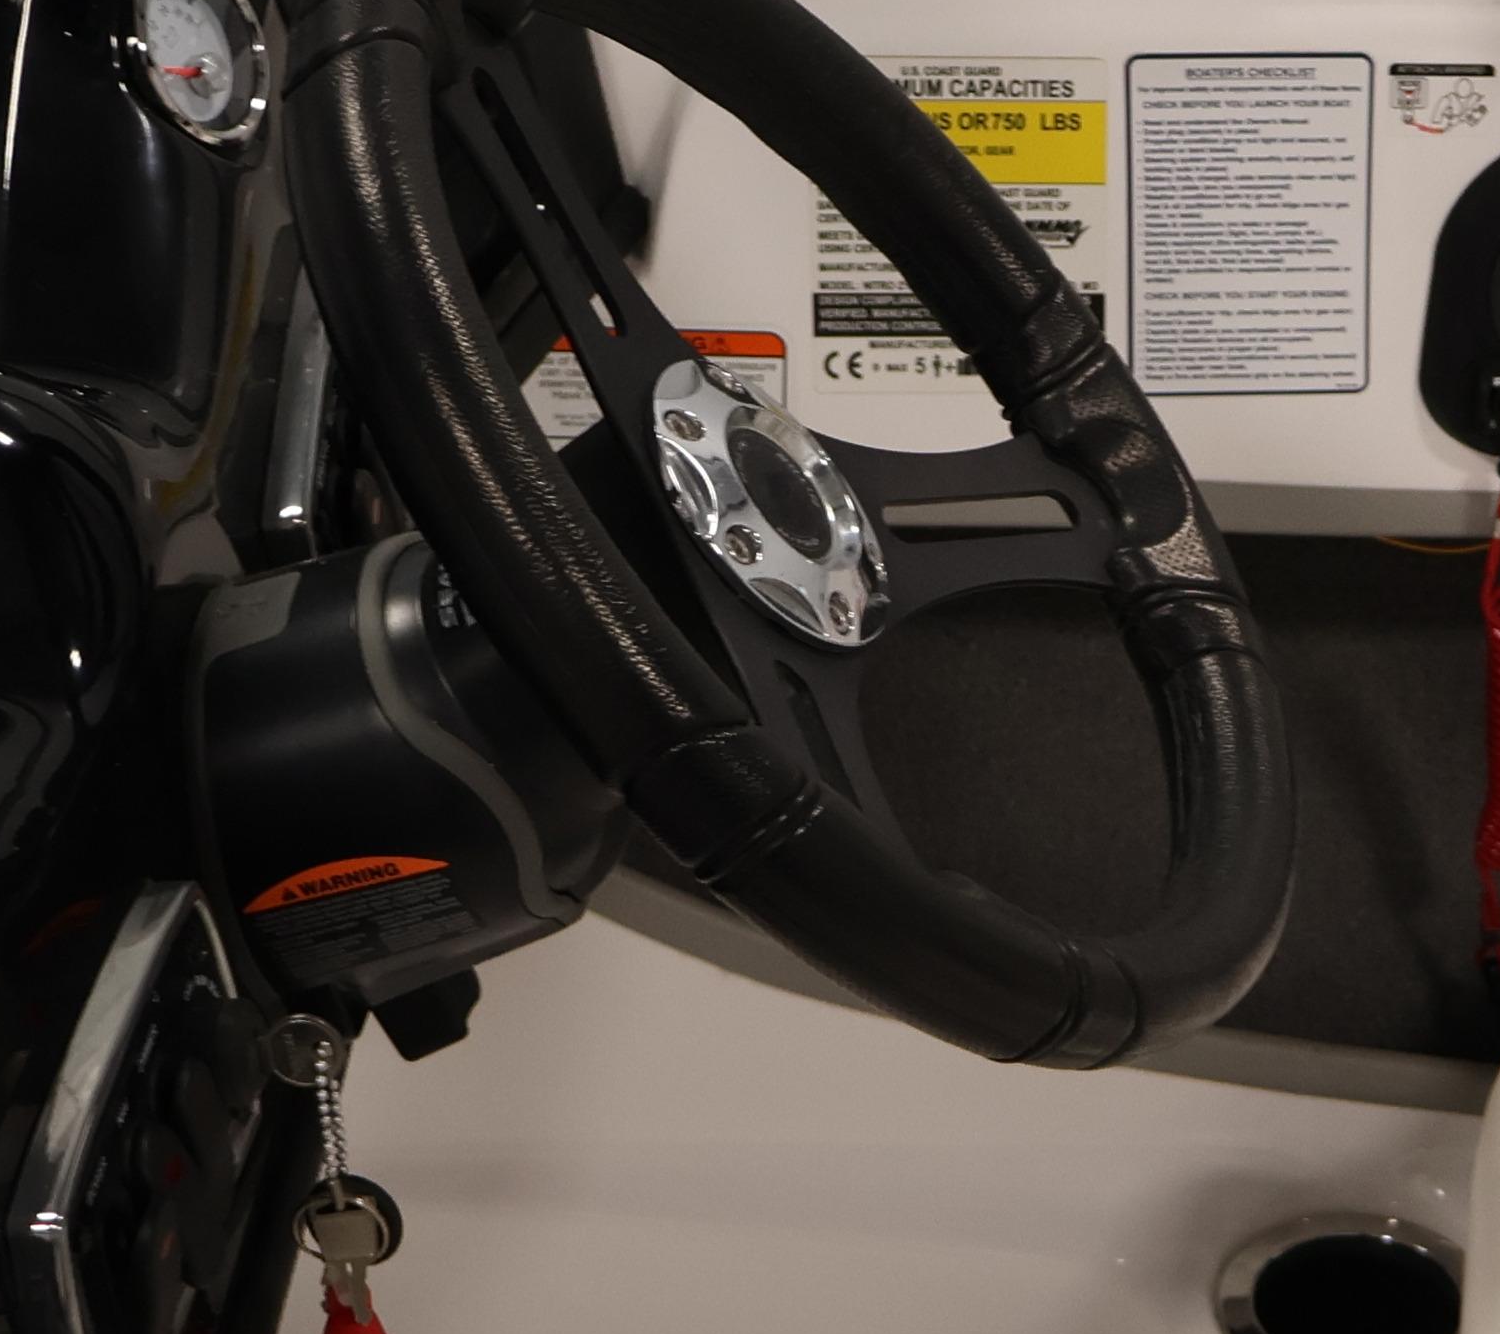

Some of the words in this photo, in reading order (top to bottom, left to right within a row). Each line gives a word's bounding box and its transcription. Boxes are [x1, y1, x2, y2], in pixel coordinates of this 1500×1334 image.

[925, 67, 961, 76] COAST
[965, 67, 1002, 76] GUARD
[1248, 68, 1316, 78] CHECKLIST
[949, 79, 1075, 98] CAPACITIES
[958, 112, 989, 131] OR
[991, 112, 1026, 131] 750
[1040, 113, 1083, 131] LBS
[824, 350, 864, 380] CE
[297, 862, 402, 897] WARNING
